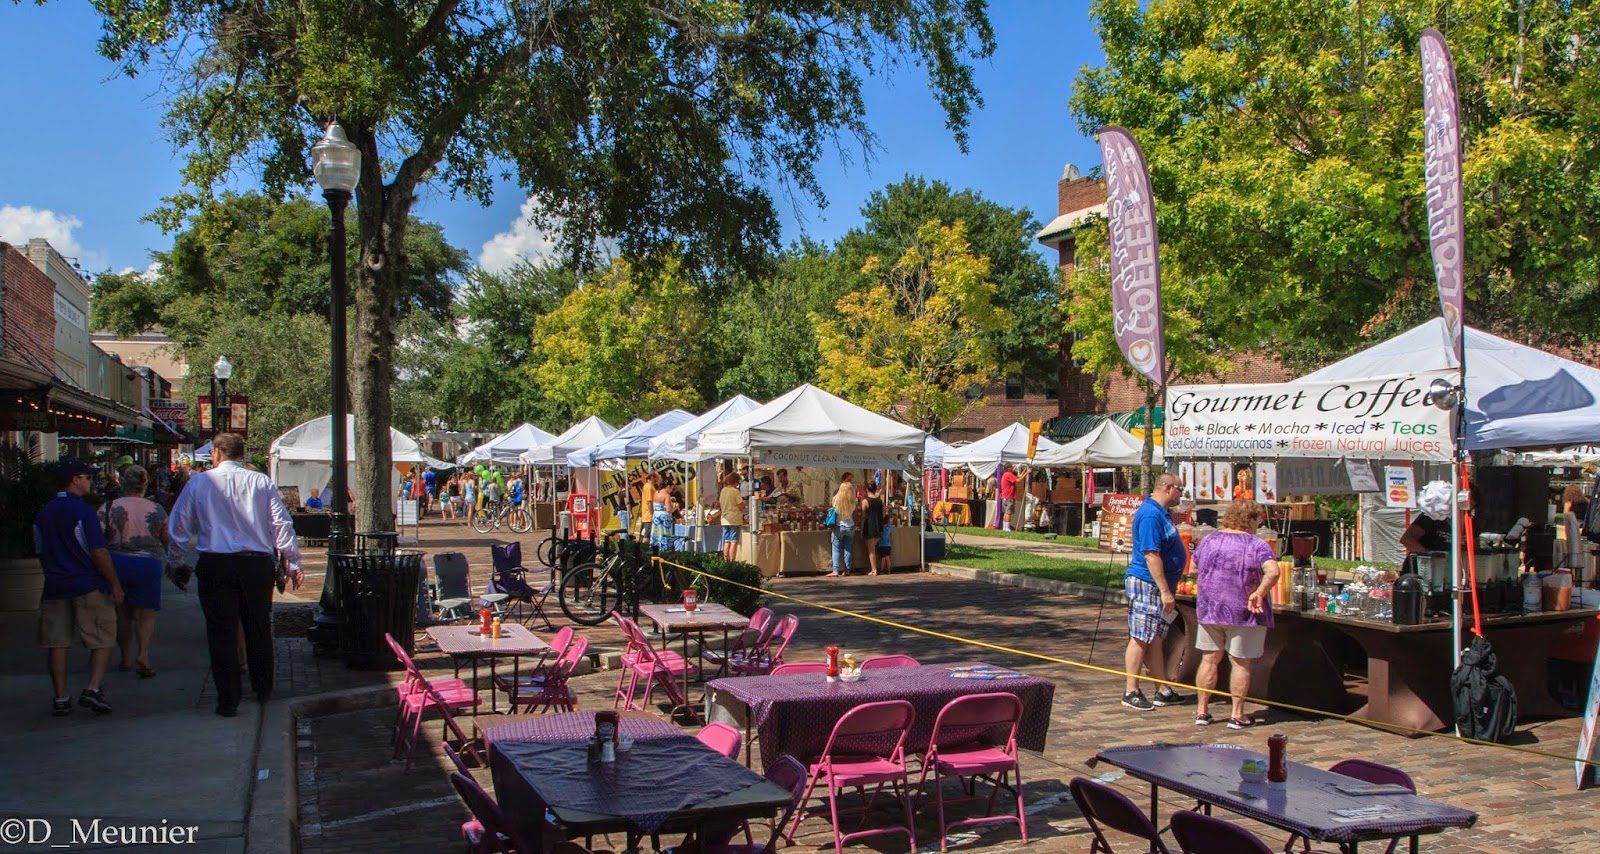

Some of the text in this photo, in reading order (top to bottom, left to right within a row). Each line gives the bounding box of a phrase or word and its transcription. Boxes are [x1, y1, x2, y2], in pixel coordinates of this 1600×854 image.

[1172, 390, 1308, 421] Gourmet
[1169, 425, 1191, 436] Latte
[1206, 422, 1241, 435] Black
[1258, 421, 1311, 435] Mocha
[1331, 420, 1366, 434] Iced
[1392, 421, 1438, 435] Teas
[1168, 436, 1441, 452] Iced Cold Frappuccinos Frozen Natural Juices
[773, 452, 838, 462] COCONUT CLEAN
[601, 481, 614, 492] THE
[612, 465, 641, 488] West
